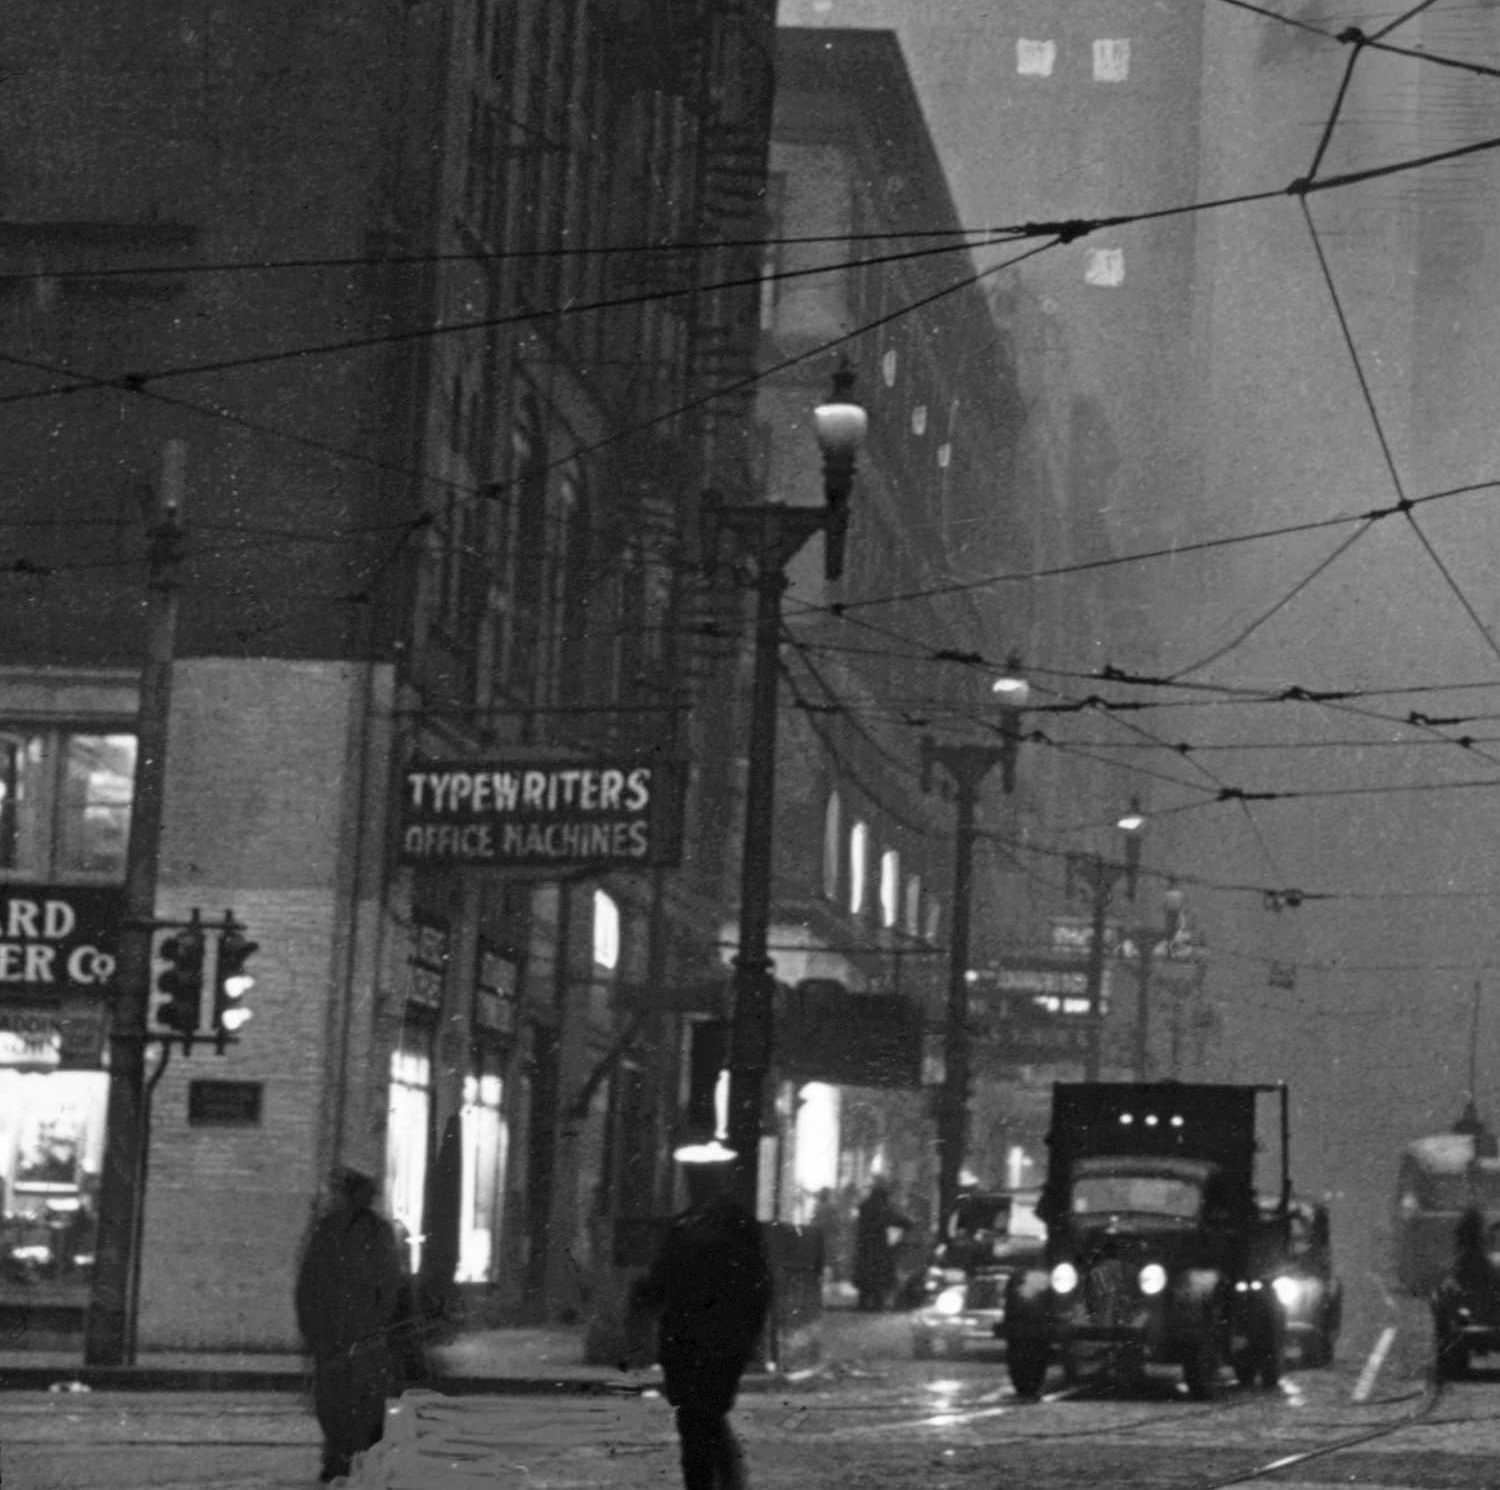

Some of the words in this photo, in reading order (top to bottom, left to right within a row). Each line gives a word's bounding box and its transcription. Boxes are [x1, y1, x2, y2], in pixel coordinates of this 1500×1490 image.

[406, 768, 652, 813] TYPEWRITERS
[403, 823, 494, 857] OFFICE
[502, 820, 649, 857] MACHINES
